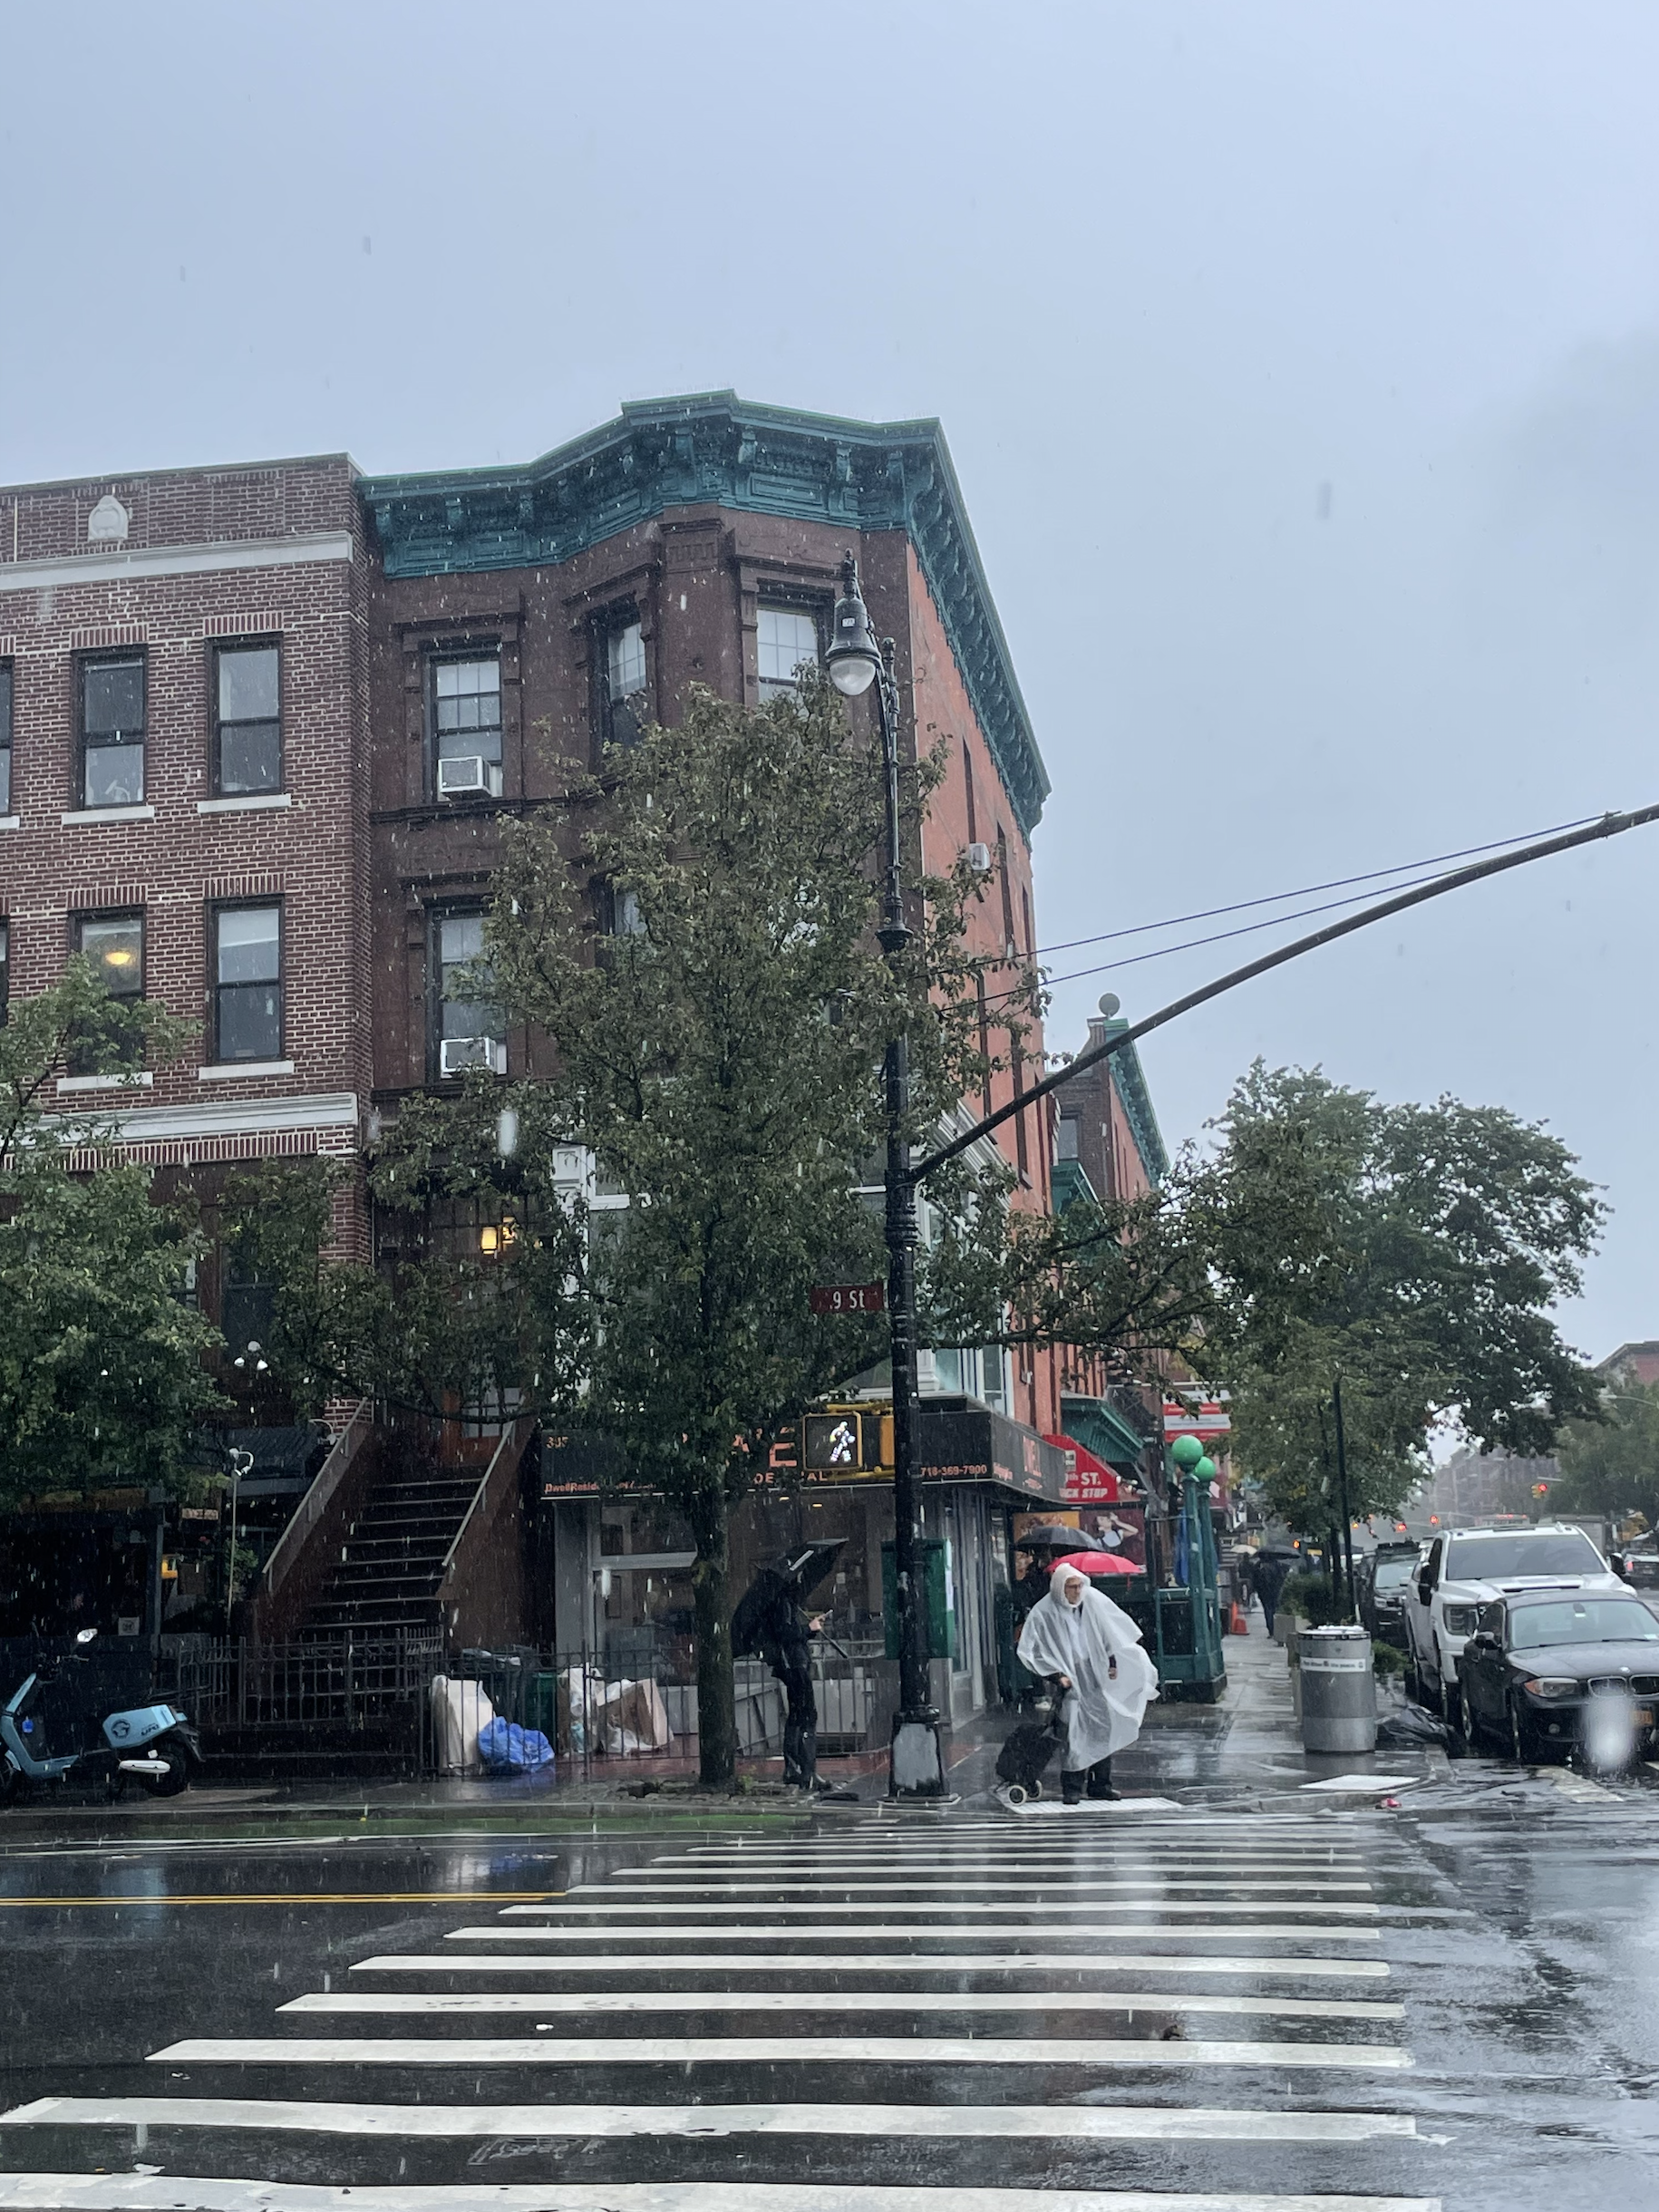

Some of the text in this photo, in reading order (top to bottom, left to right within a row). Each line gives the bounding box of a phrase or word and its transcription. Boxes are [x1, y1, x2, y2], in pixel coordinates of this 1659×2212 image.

[849, 1289, 865, 1309] St
[1081, 1471, 1101, 1486] ST.
[1082, 1488, 1109, 1499] STOP
